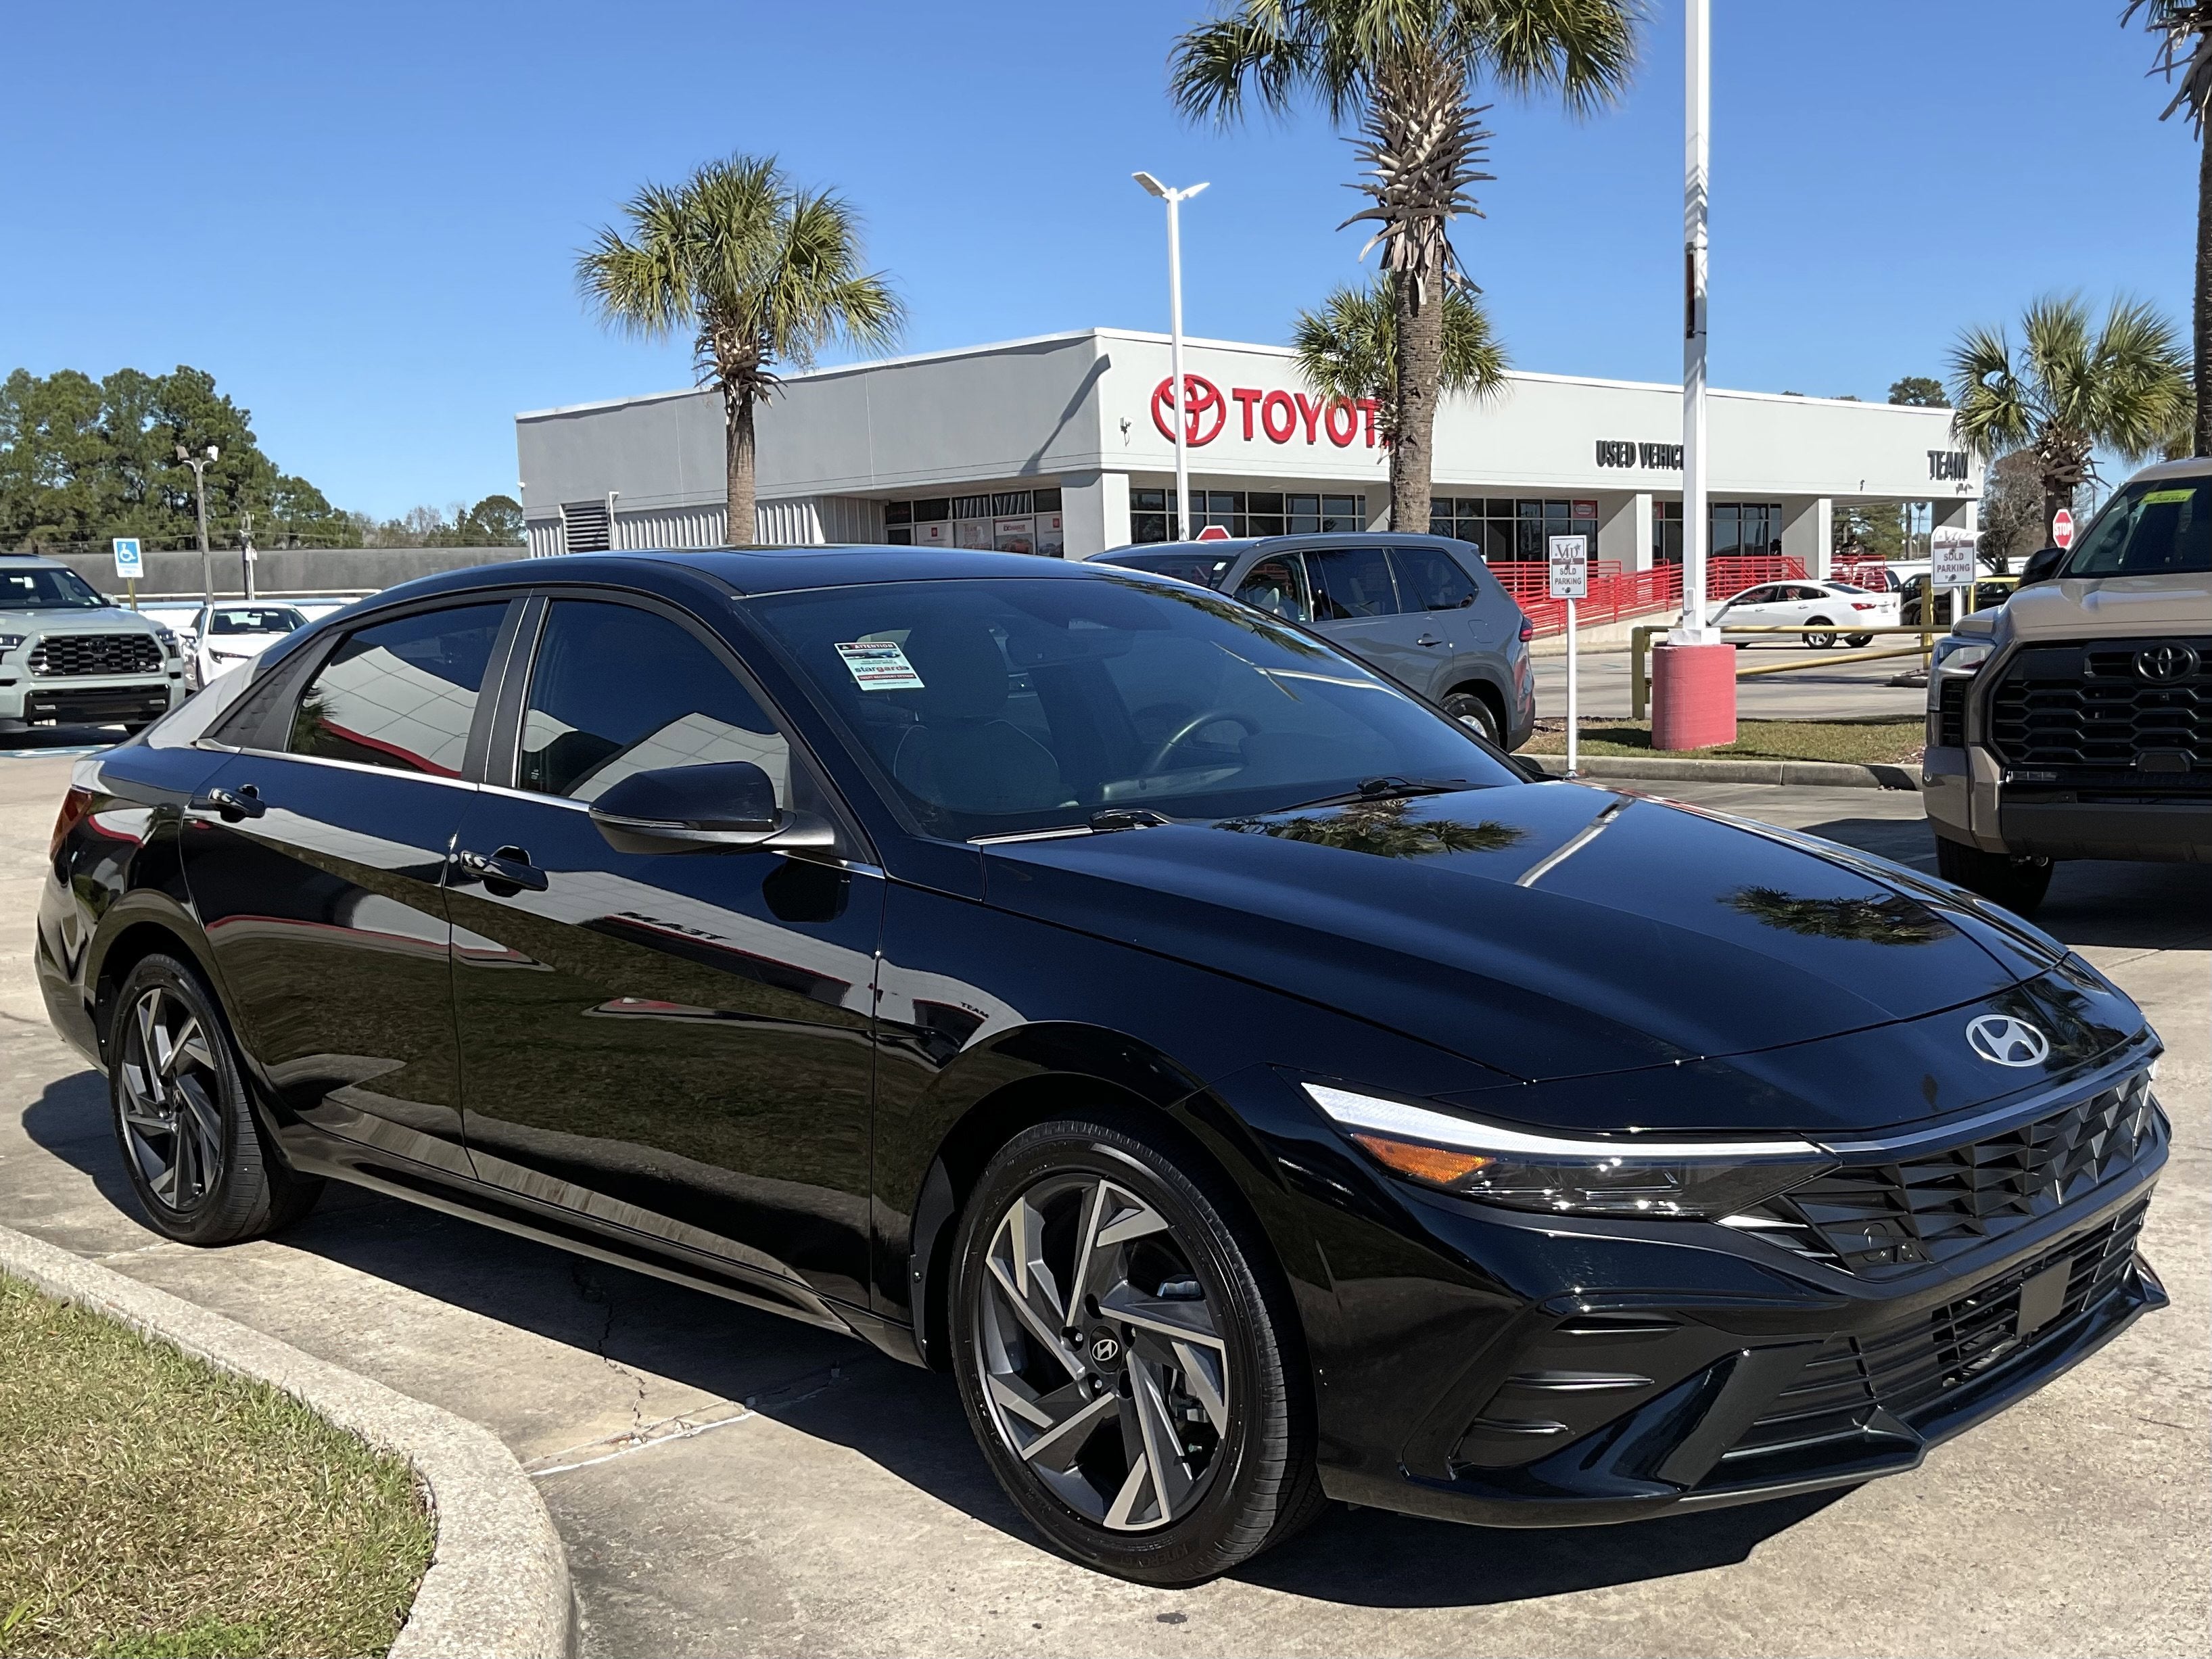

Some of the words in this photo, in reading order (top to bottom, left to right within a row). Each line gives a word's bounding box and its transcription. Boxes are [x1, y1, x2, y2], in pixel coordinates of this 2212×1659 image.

[1232, 388, 1391, 449] TOYOT
[1595, 440, 1637, 468] USED
[1927, 450, 1969, 482] TEAM
[2054, 522, 2071, 536] STOP
[1943, 553, 1964, 561] SOLD
[1559, 567, 1576, 576] SOLD
[1937, 563, 1971, 573] PARKING
[1554, 577, 1582, 585] PARKING
